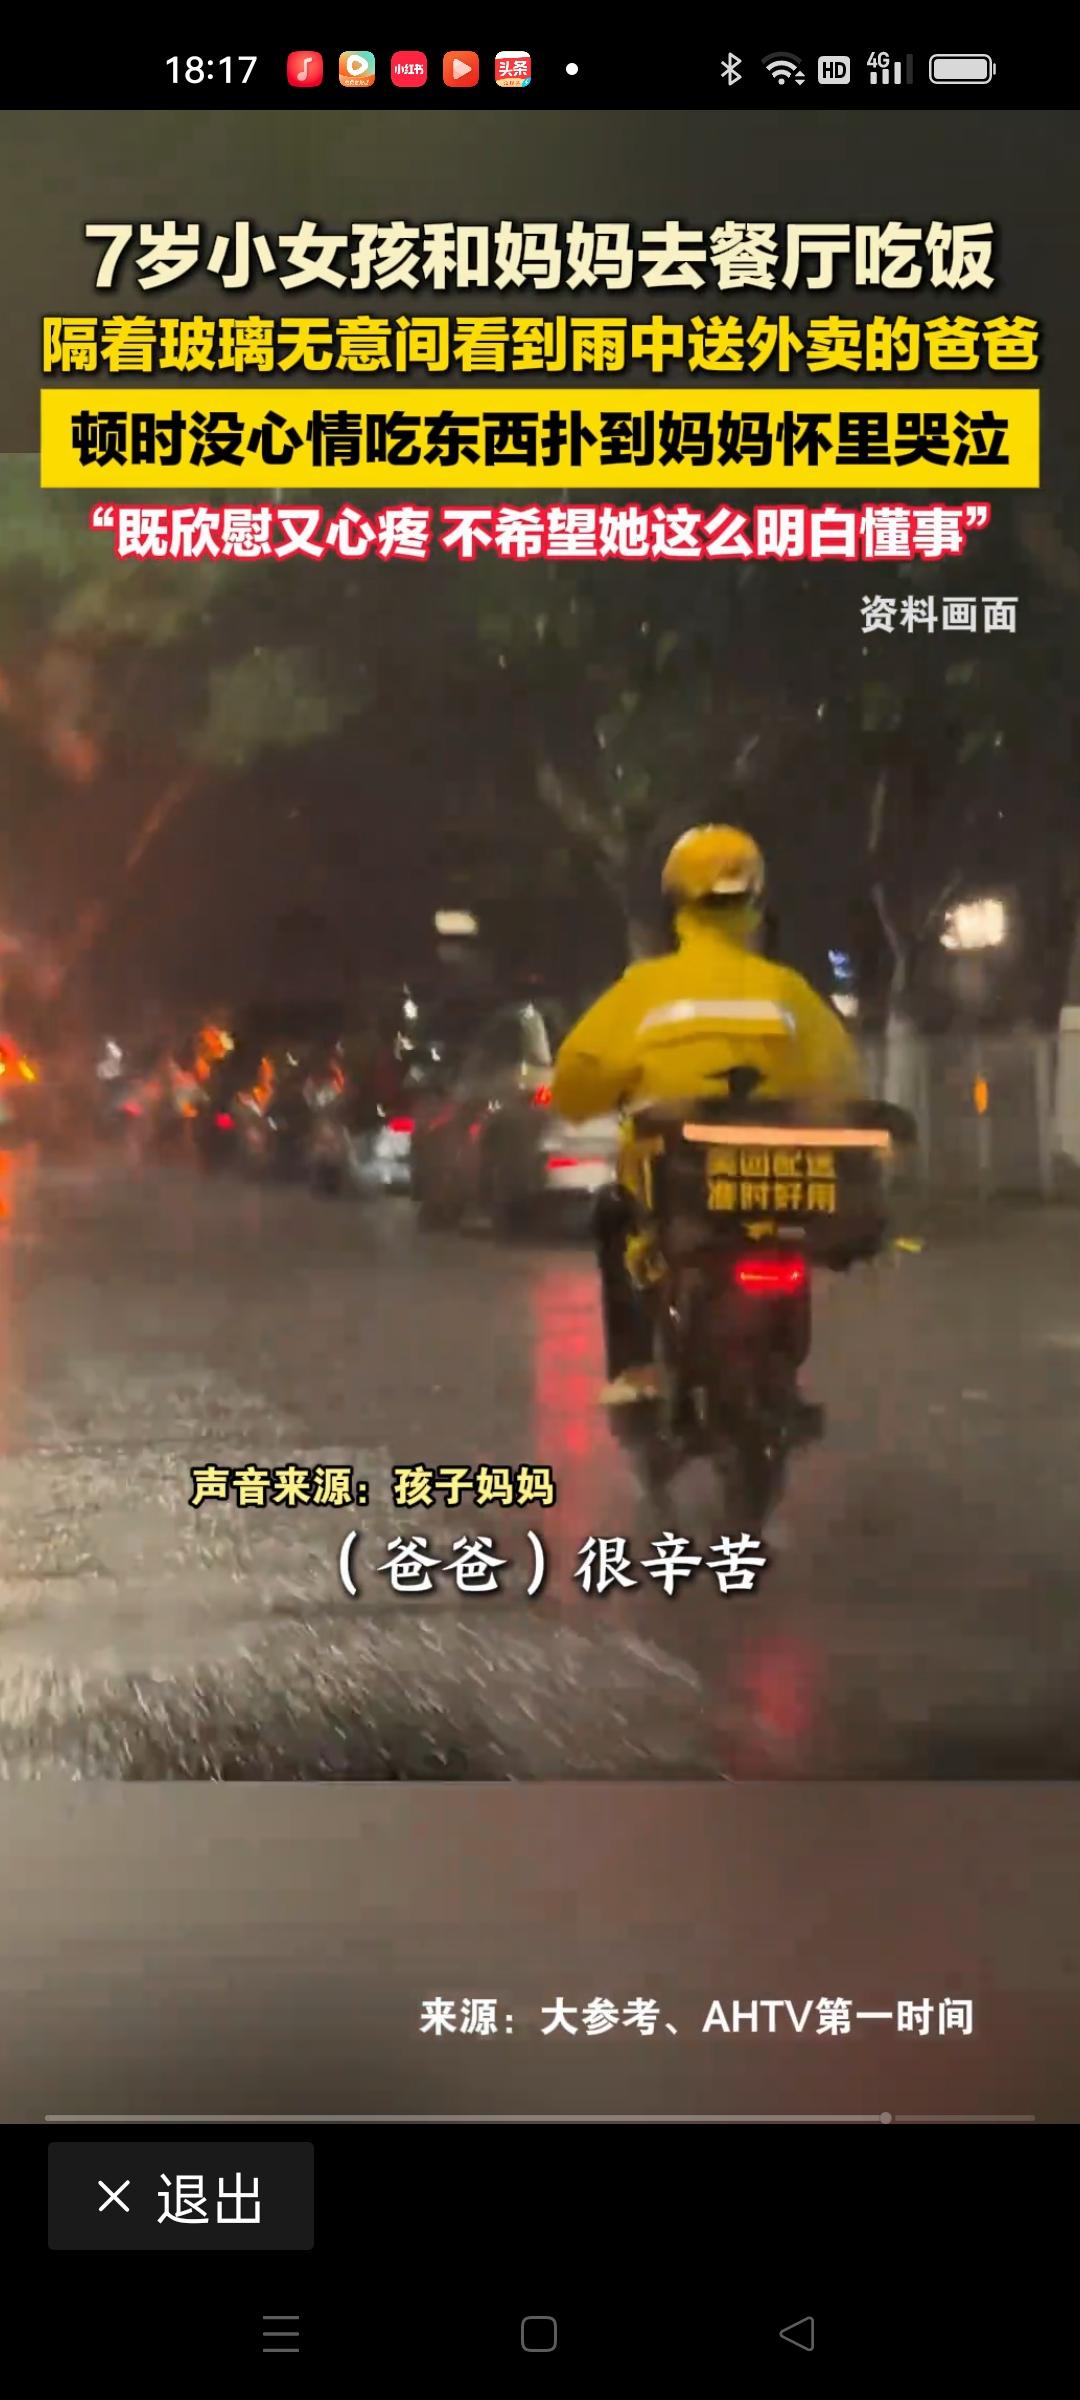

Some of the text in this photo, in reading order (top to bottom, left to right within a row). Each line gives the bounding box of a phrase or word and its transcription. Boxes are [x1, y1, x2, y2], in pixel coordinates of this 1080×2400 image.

[866, 51, 890, 68] 4G
[166, 55, 258, 84] 18:17
[394, 63, 424, 75] 小红书
[499, 60, 528, 77] 头条
[822, 61, 847, 79] HD
[156, 2171, 261, 2224] 退出
